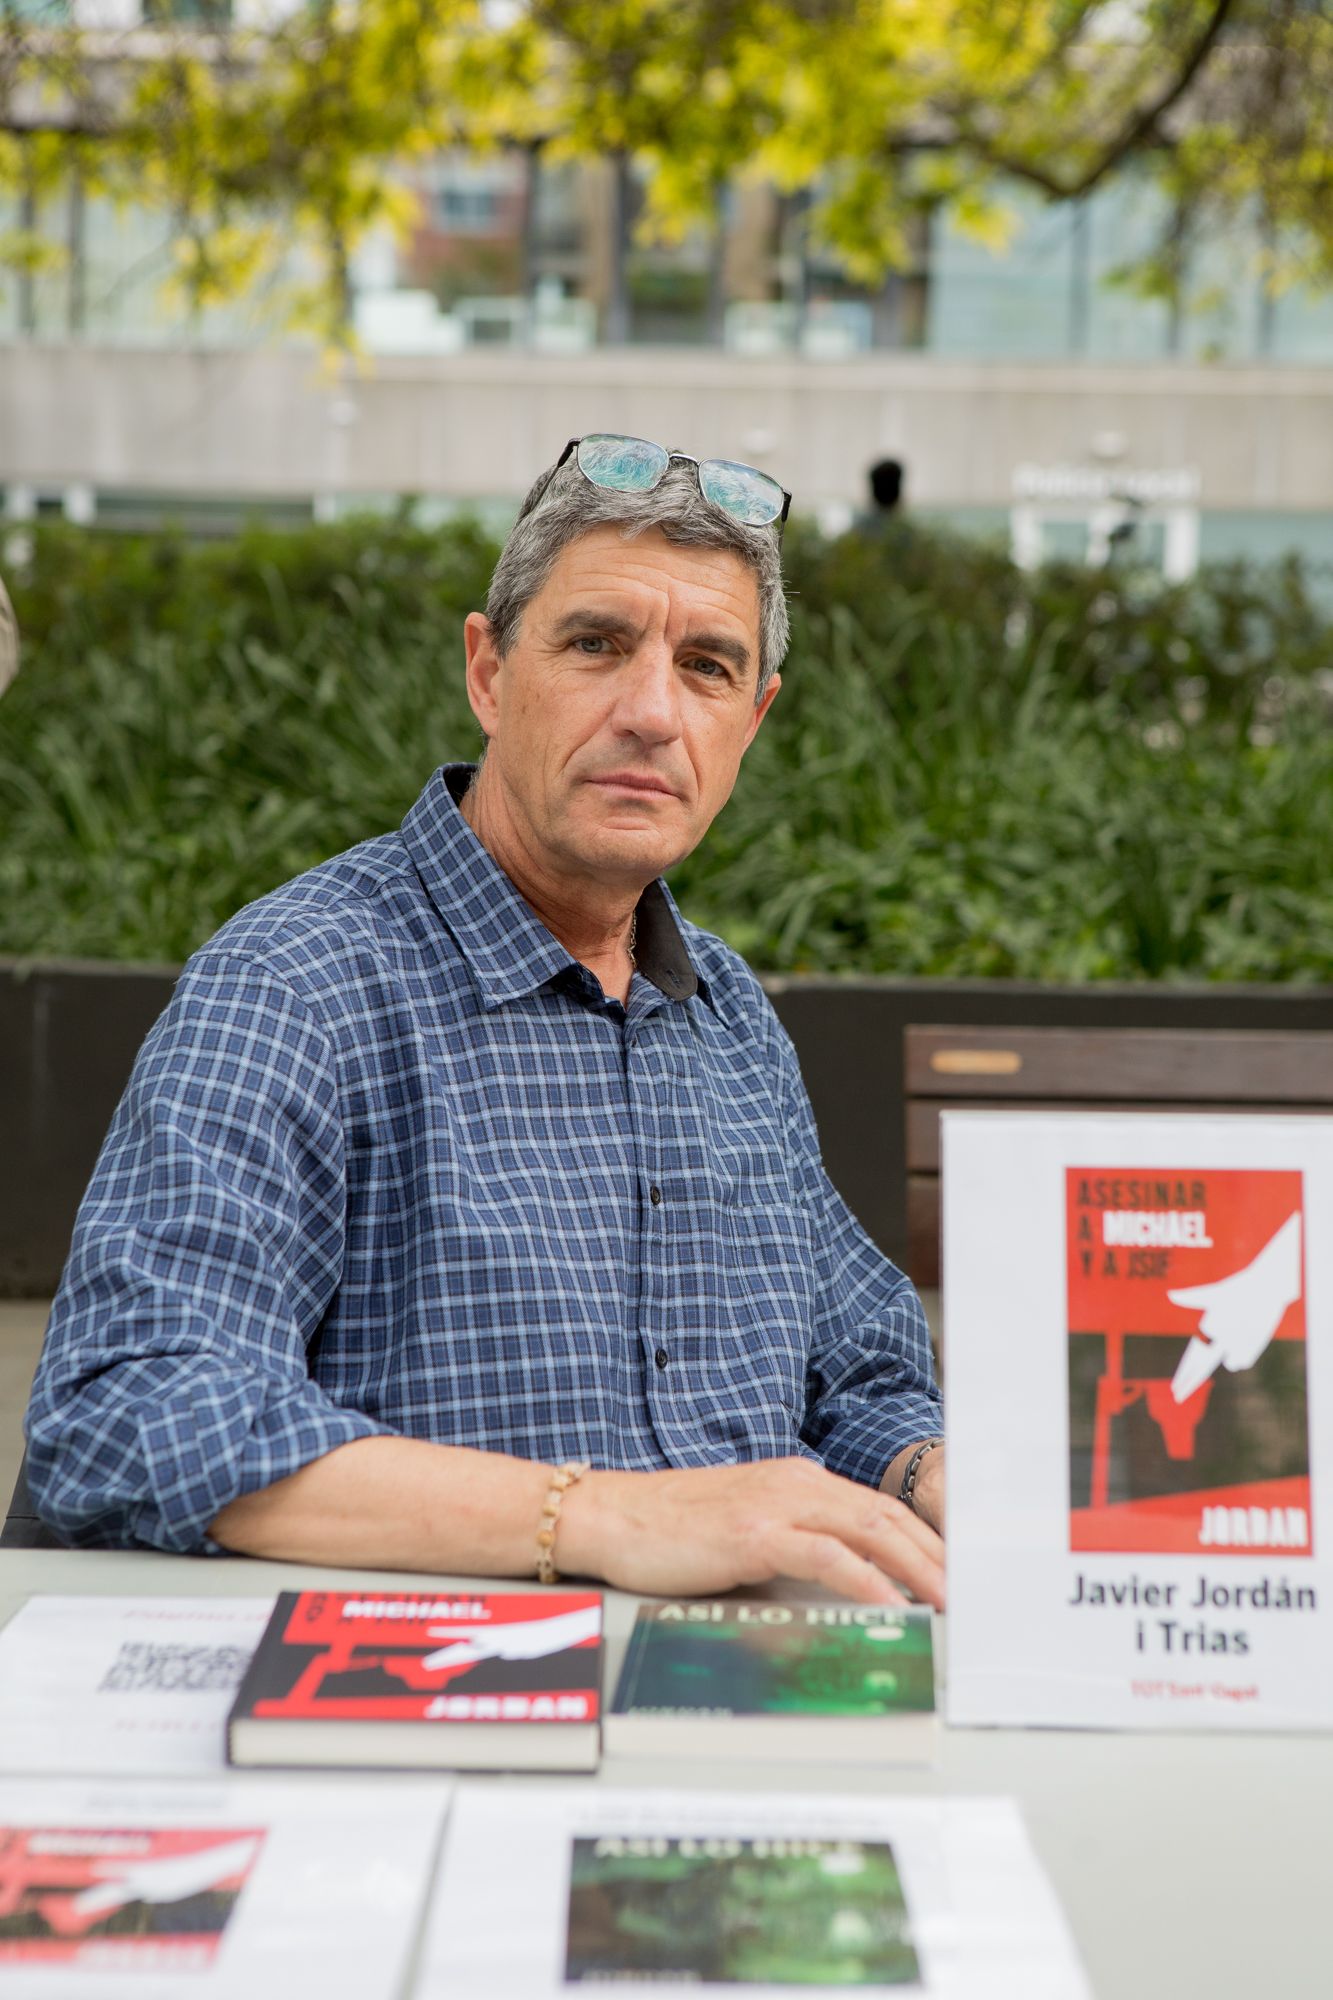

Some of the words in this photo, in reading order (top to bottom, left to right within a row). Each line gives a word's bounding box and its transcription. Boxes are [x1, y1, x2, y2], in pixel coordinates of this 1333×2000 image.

[1077, 1179, 1206, 1208] ASESINAR
[1079, 1214, 1093, 1242] A
[1102, 1210, 1213, 1248] MICHAEL
[1080, 1250, 1094, 1277] Y
[1102, 1250, 1118, 1278] A
[1198, 1505, 1307, 1548] JORDAN
[1069, 1574, 1176, 1608] Javier
[1191, 1576, 1317, 1610] Jordán
[342, 1600, 491, 1619] MICHAEL
[737, 1605, 793, 1625] LO
[1136, 1620, 1145, 1653] i
[1159, 1621, 1250, 1655] Trias
[423, 1695, 587, 1720] JORDAN
